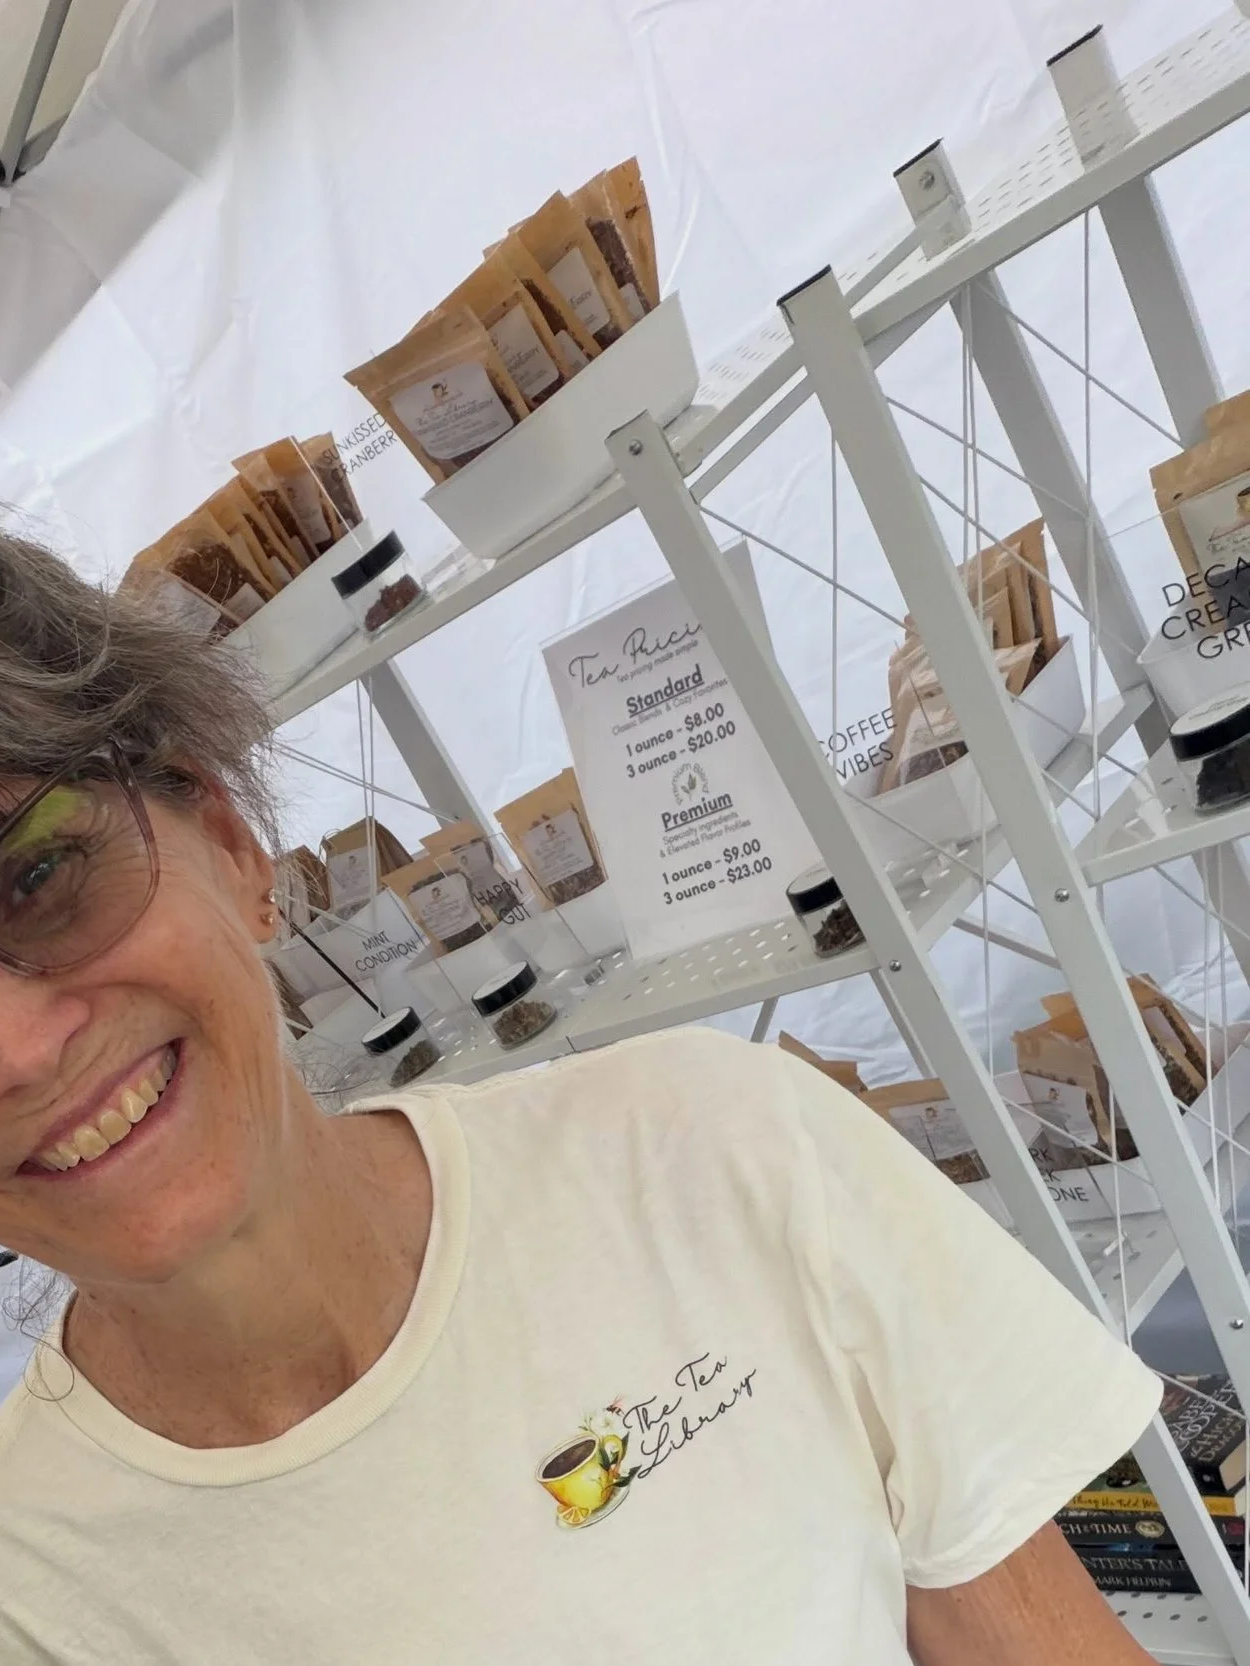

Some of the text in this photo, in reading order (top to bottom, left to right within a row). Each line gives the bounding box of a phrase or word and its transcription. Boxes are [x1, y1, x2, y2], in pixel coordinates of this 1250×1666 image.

[322, 412, 387, 465] SUNKISSED
[331, 430, 398, 481] CRANBERR
[1162, 556, 1250, 607] DECA
[1162, 595, 1250, 641] CREA
[568, 623, 703, 688] Tea Prici
[629, 662, 654, 682] pricing
[653, 651, 675, 667] made
[674, 639, 699, 657] simple
[612, 719, 638, 736] Classic
[638, 708, 663, 724] Blends
[673, 693, 694, 711] Cozy
[693, 677, 729, 699] Favorites
[626, 663, 704, 717] Standard
[626, 763, 635, 778] 3
[638, 750, 677, 775] ounce
[687, 720, 737, 753] $20.00
[635, 728, 674, 754] ounce
[684, 702, 725, 733] $8.00
[836, 740, 895, 780] VIBES
[661, 793, 733, 832] Premium
[667, 837, 700, 857] Elevated
[700, 829, 724, 844] Flavor
[671, 859, 713, 883] ounce
[723, 838, 761, 865] $9.00
[474, 878, 525, 906] HAPPY
[663, 891, 673, 905] 3
[675, 879, 717, 903] ounce
[726, 856, 772, 884] $23.00
[500, 902, 532, 926] GUT
[355, 938, 418, 973] CONDITION
[362, 930, 393, 951] MINT
[1030, 1147, 1055, 1162] RK
[1052, 1186, 1091, 1203] ONE
[622, 1352, 729, 1434] The Tea
[637, 1368, 758, 1480] Library
[1058, 1522, 1082, 1535] CH
[1089, 1523, 1132, 1535] TIME
[1081, 1556, 1144, 1571] NTER'S
